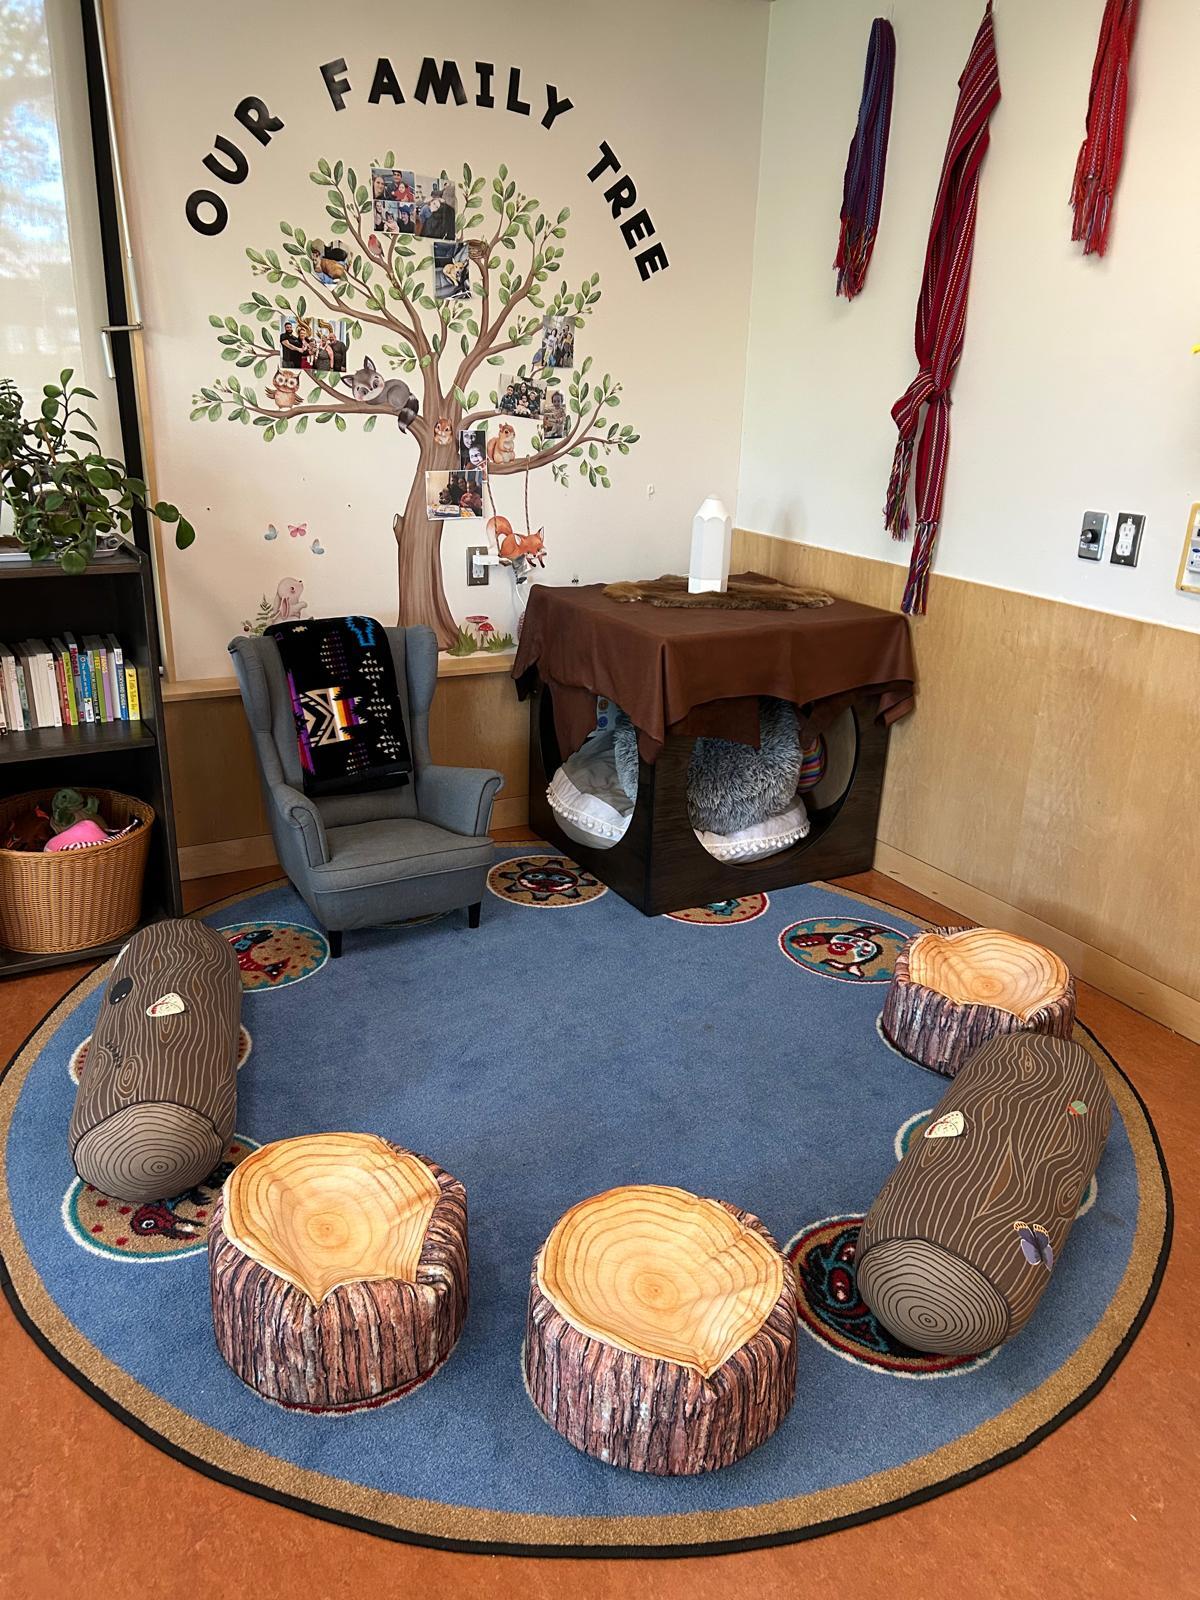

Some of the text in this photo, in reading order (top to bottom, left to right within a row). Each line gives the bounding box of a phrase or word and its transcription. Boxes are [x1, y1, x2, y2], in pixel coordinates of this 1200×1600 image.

[185, 57, 670, 282] OUR FAMILY TREE
[70, 647, 80, 676] Moose!
